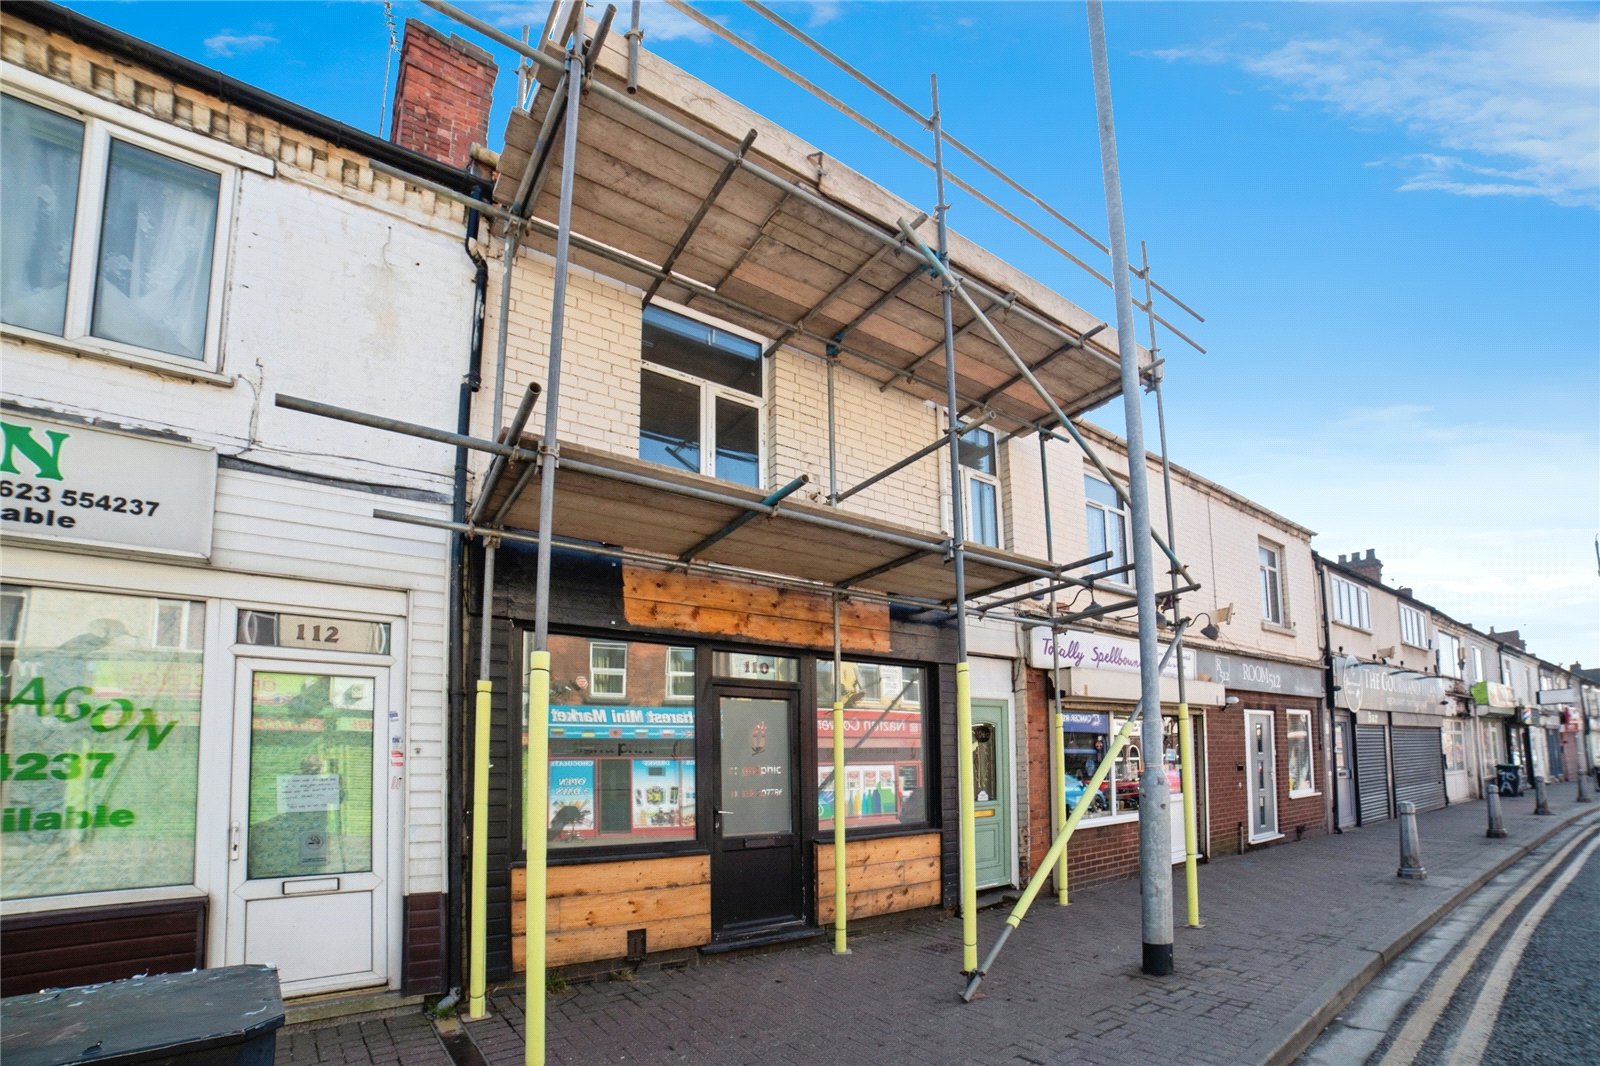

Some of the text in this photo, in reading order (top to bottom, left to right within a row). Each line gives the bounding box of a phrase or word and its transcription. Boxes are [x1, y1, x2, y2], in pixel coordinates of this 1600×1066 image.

[60, 489, 160, 517] 554237
[0, 507, 76, 528] able
[296, 624, 339, 643] 112
[744, 660, 769, 675] 110
